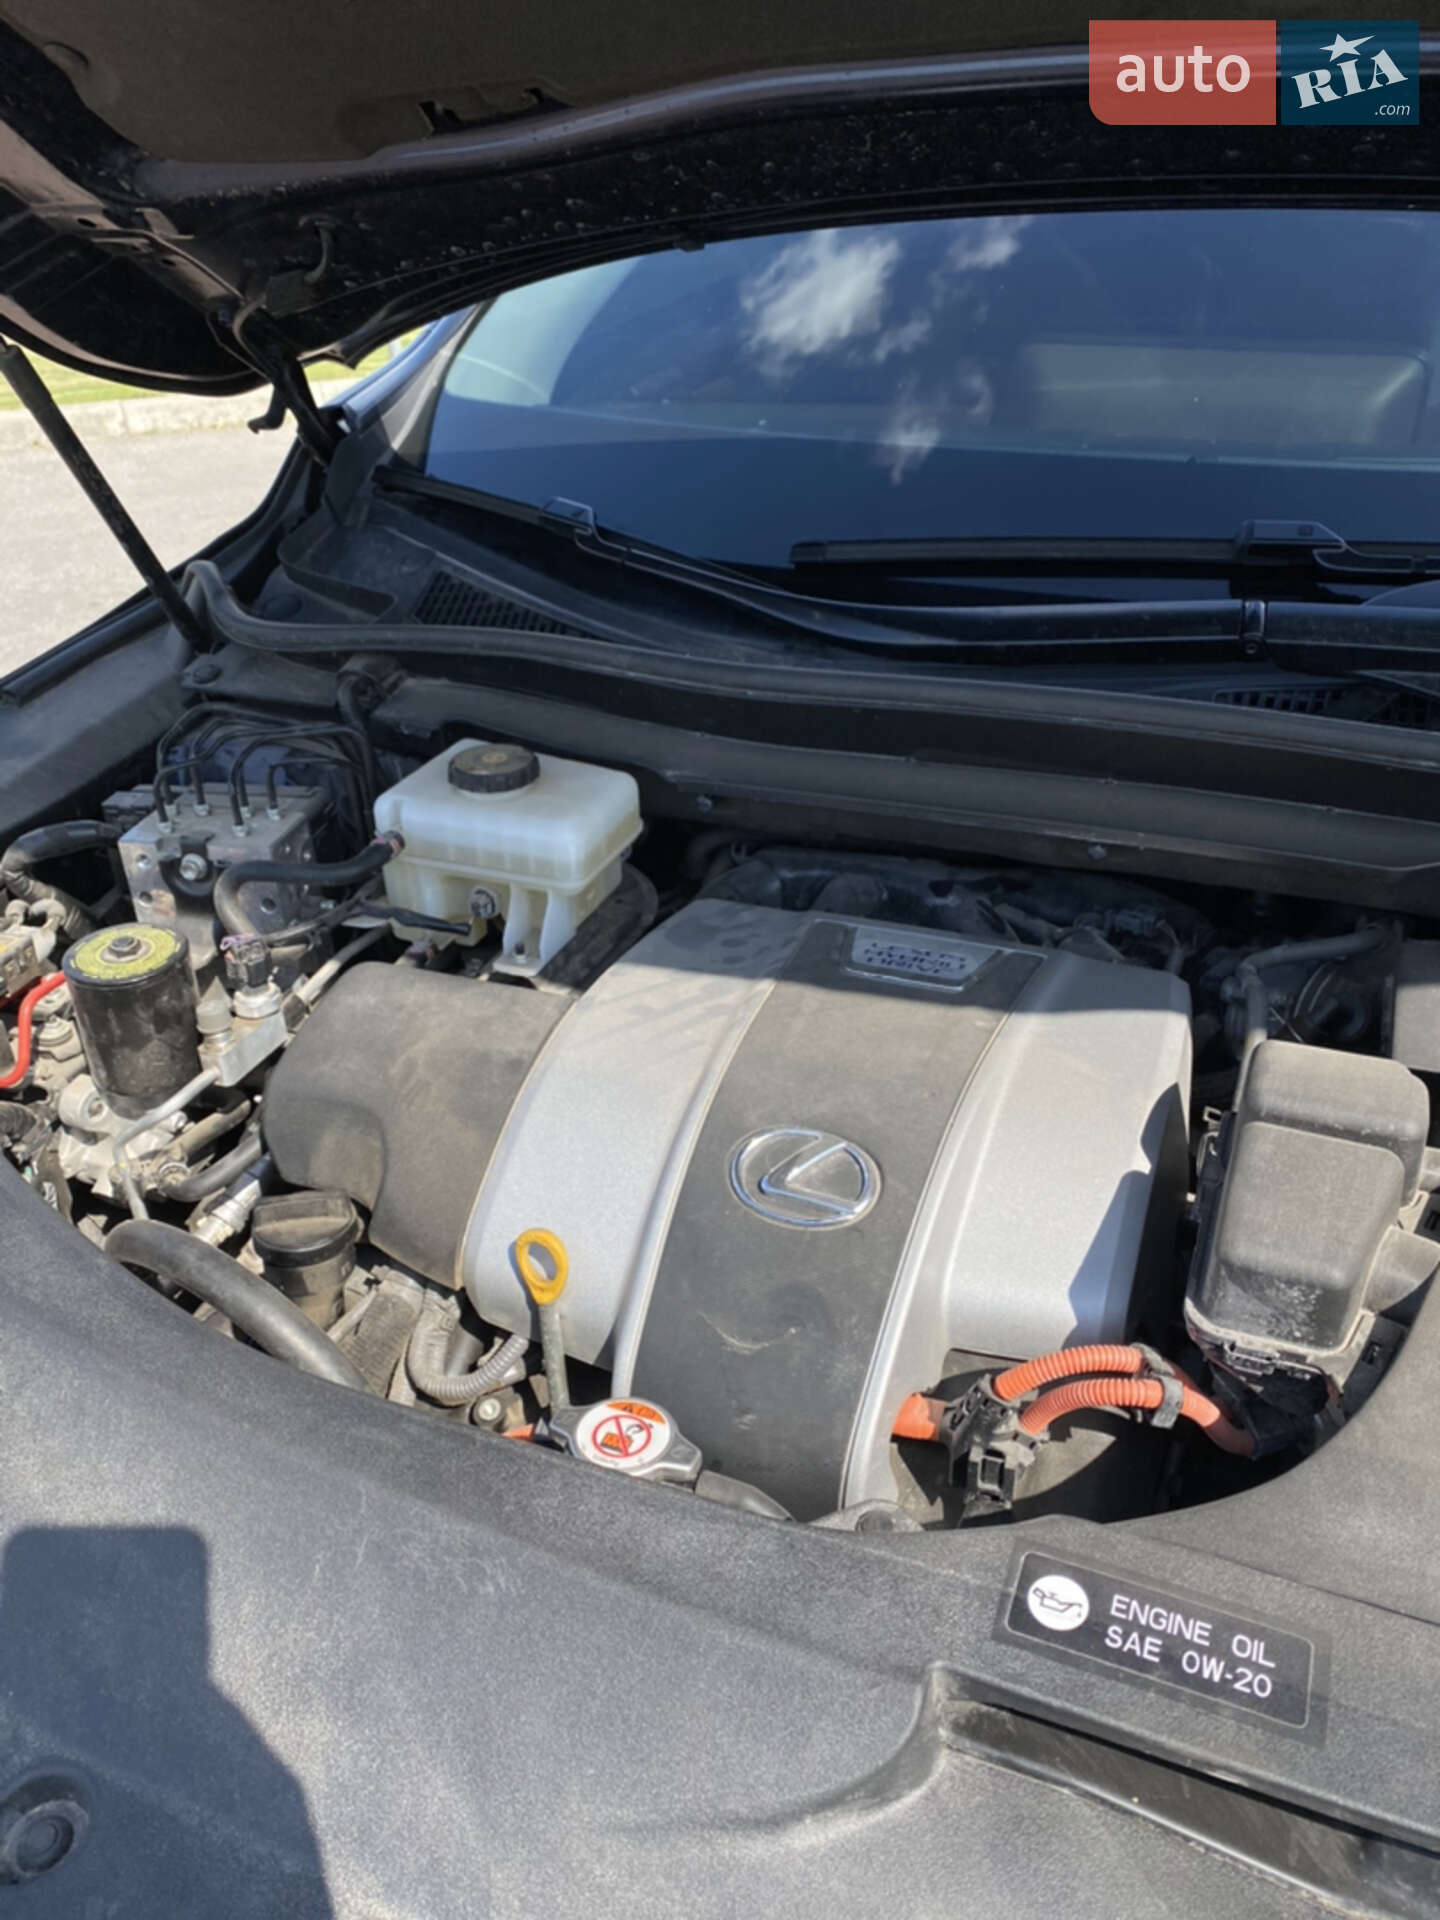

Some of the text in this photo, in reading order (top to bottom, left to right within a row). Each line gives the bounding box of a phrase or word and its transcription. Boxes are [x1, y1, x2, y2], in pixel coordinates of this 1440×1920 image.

[1104, 1626, 1272, 1698] SAE 0W-20
[1110, 1594, 1276, 1668] ENGINE OIL
